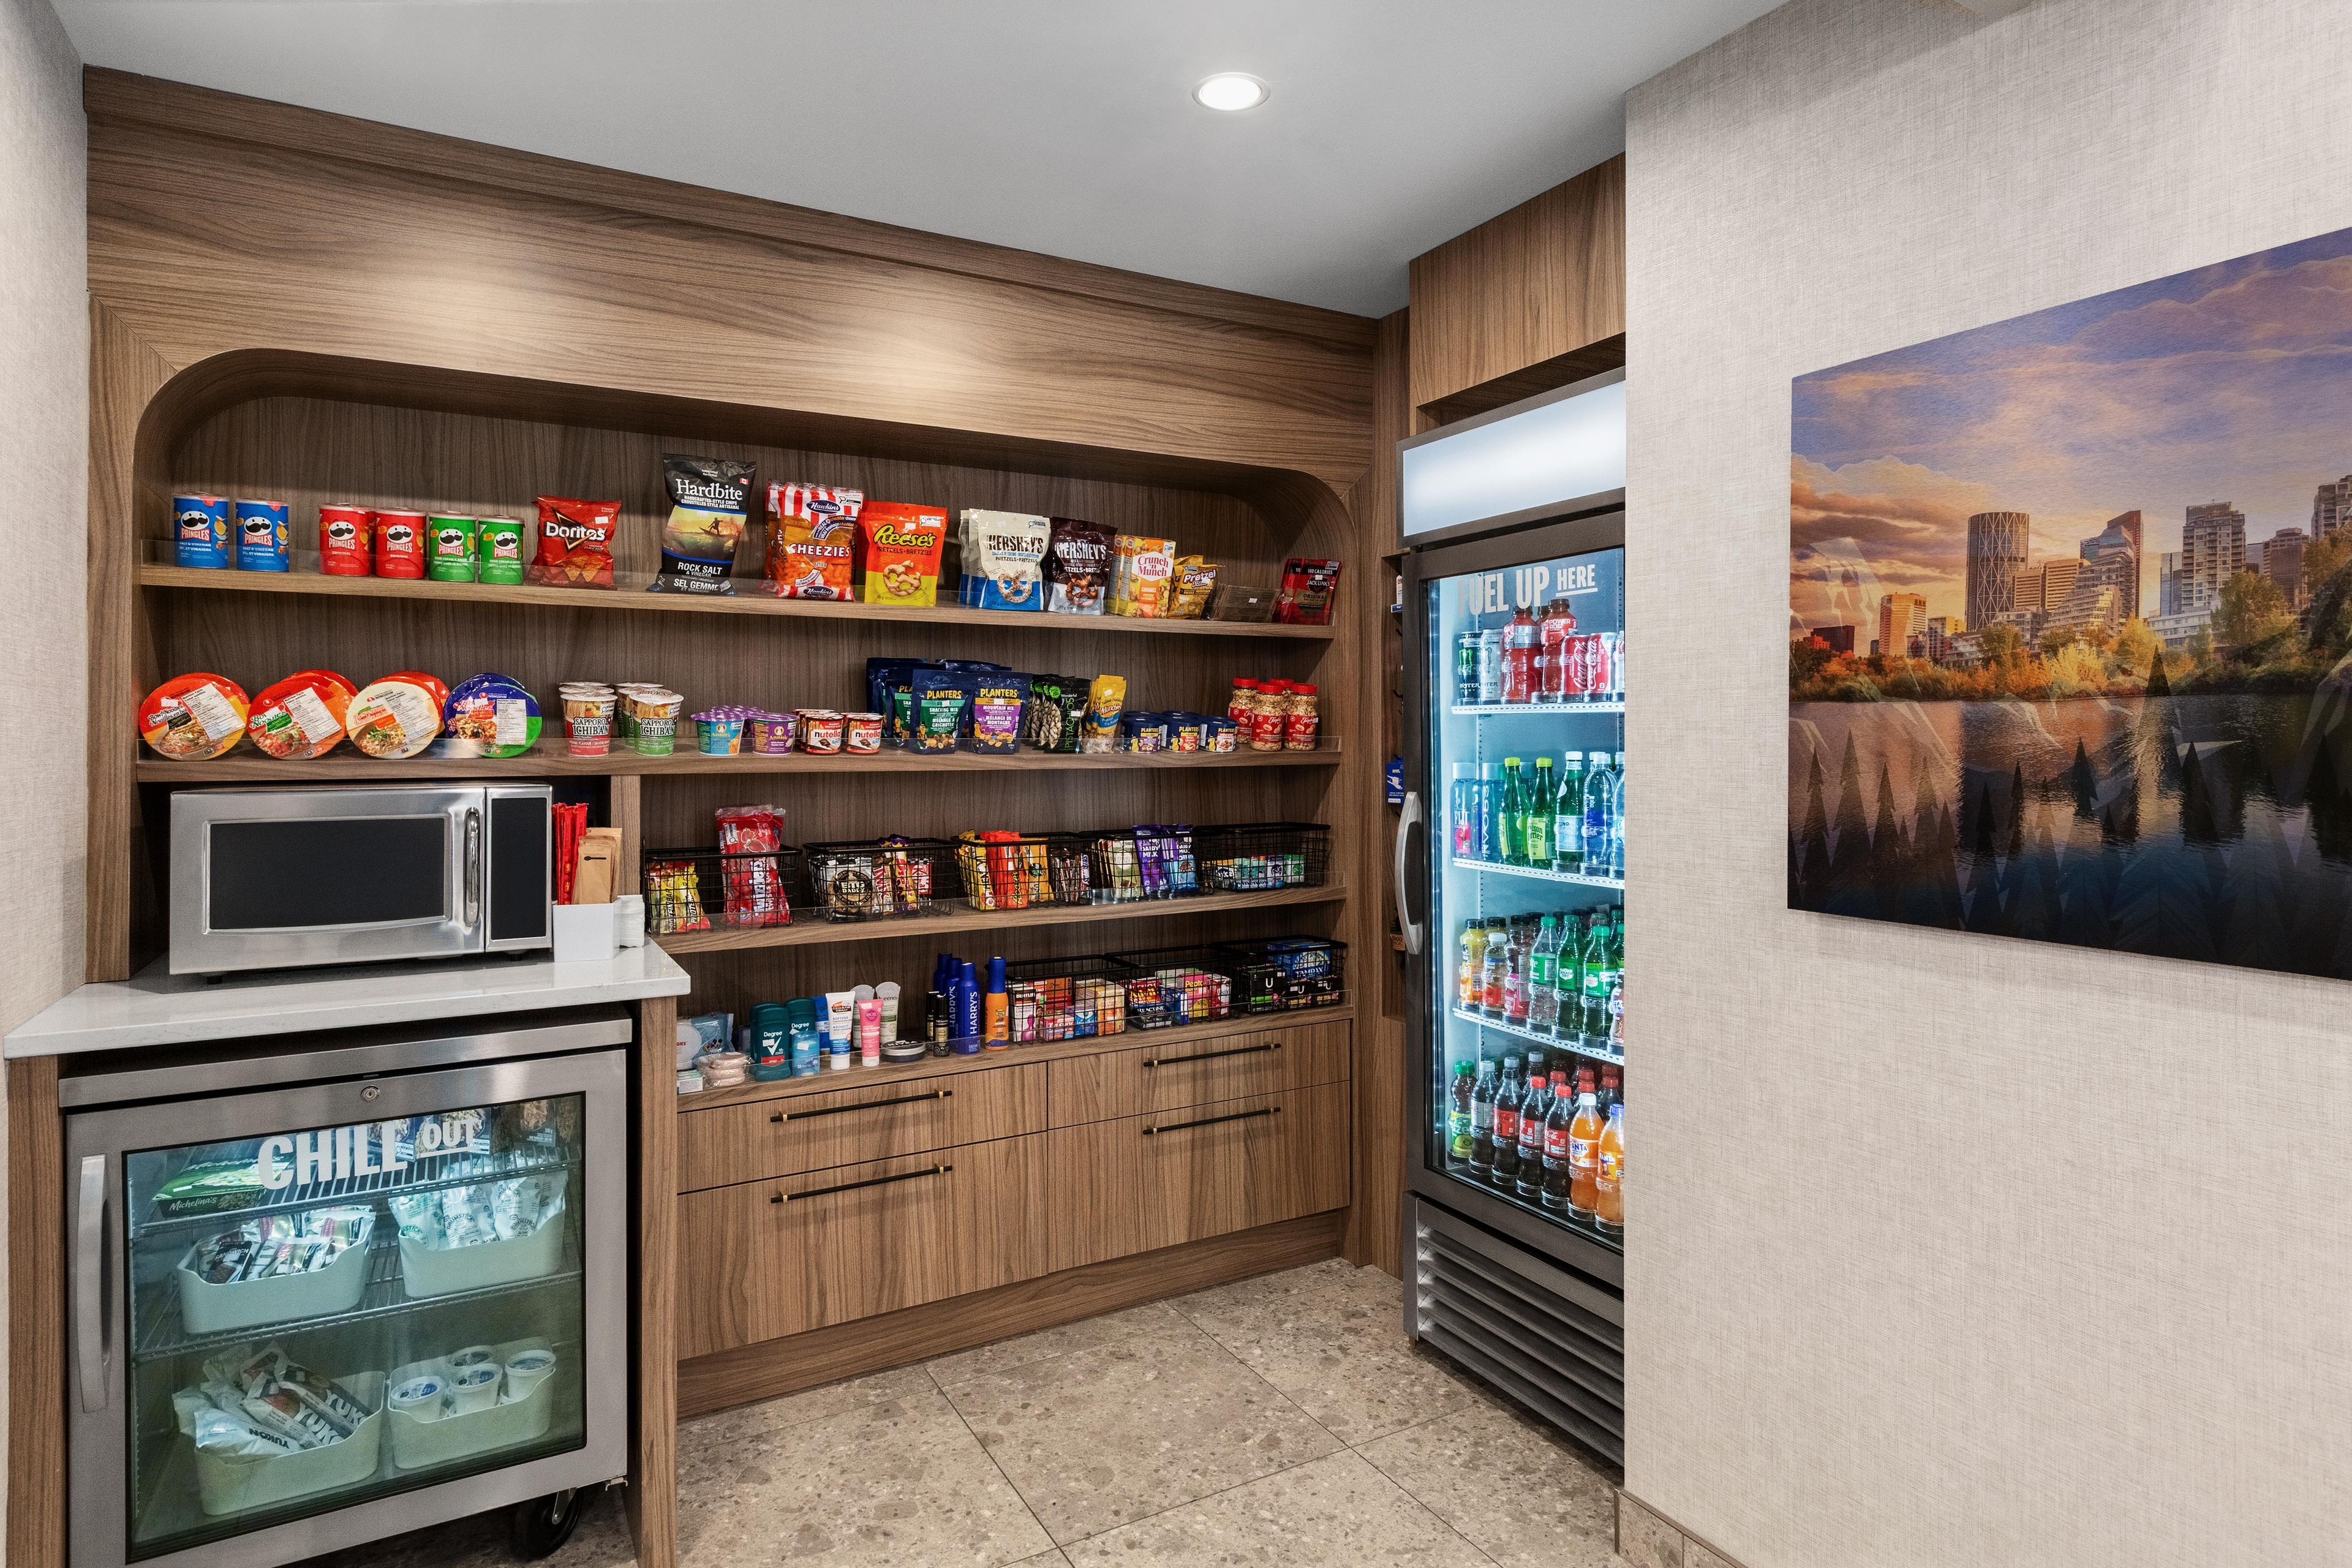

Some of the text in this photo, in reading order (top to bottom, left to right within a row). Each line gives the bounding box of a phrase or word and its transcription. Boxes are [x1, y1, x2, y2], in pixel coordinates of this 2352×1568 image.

[676, 478, 743, 500] Hardbite
[684, 495, 725, 504] HANDCRAFTED-STYLE
[810, 502, 839, 511] Hawkins
[181, 528, 209, 541] PRINGLES
[546, 522, 606, 541] Doritos
[874, 524, 936, 547] Reese's
[245, 533, 272, 546] PRINGLES
[329, 538, 355, 549] PRINGLES
[989, 535, 1044, 554] HERSHEY'S
[387, 541, 412, 552] PRINGLES
[439, 545, 463, 557] PRINGLES
[788, 543, 850, 557] CHEEZIES
[1057, 541, 1107, 560] HERSHEY'S
[494, 548, 518, 559] PRINGLES
[677, 562, 722, 575] ROCK SALT
[1137, 556, 1169, 568] Crunch
[1137, 565, 1167, 576] Munch
[1183, 569, 1216, 583] Pretzel
[674, 578, 688, 588] SEL
[1457, 564, 1596, 618] FUEL UP HERE
[927, 690, 962, 699] PLANTERS
[980, 688, 1018, 698] PLANTERS
[148, 710, 164, 722] Bowl
[1065, 698, 1075, 748] PISTACHIOS
[573, 725, 609, 735] ICHIBAN
[639, 725, 675, 735] ICHIBAN
[1453, 810, 1469, 825] FIJI
[748, 860, 766, 917] Twizzlers
[1295, 967, 1323, 976] TAMPAX
[1265, 978, 1273, 988] U
[1298, 986, 1305, 994] U
[257, 1118, 475, 1189] CHILL OUT
[169, 1196, 217, 1212] Michelina's
[447, 1213, 475, 1230] DRUMSTICK
[510, 1218, 535, 1231] DRUMSTICK
[249, 1427, 290, 1450] YUKON
